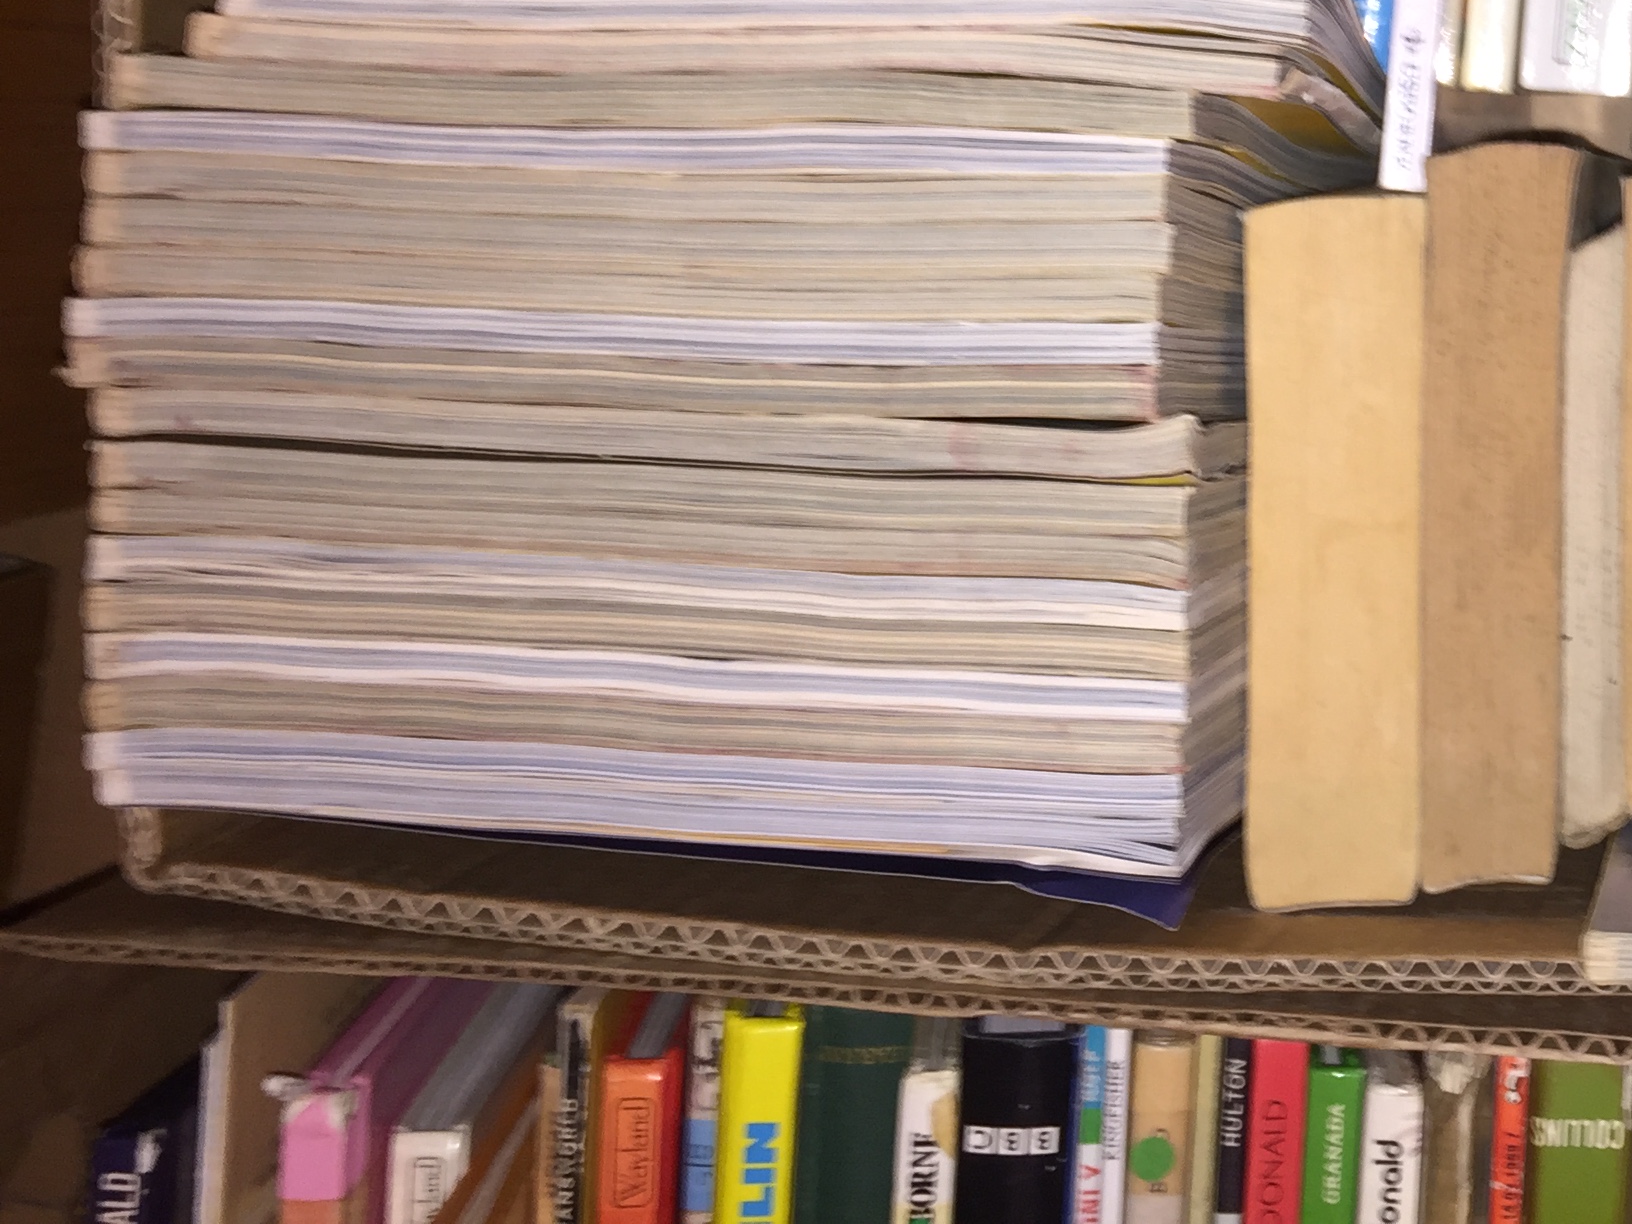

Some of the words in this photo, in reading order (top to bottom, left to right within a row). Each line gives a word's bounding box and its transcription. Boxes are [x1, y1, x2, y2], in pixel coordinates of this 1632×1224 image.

[1103, 1060, 1126, 1162] KINGFISHER
[1219, 1059, 1248, 1148] HULTON
[1530, 1117, 1626, 1150] COLLINS
[96, 1172, 141, 1224] ALD
[615, 1105, 655, 1204] Wayland
[737, 1122, 780, 1224] LIN
[1257, 1099, 1289, 1224] ONALD
[1321, 1104, 1346, 1205] GRANADA
[1374, 1139, 1403, 1224] onald
